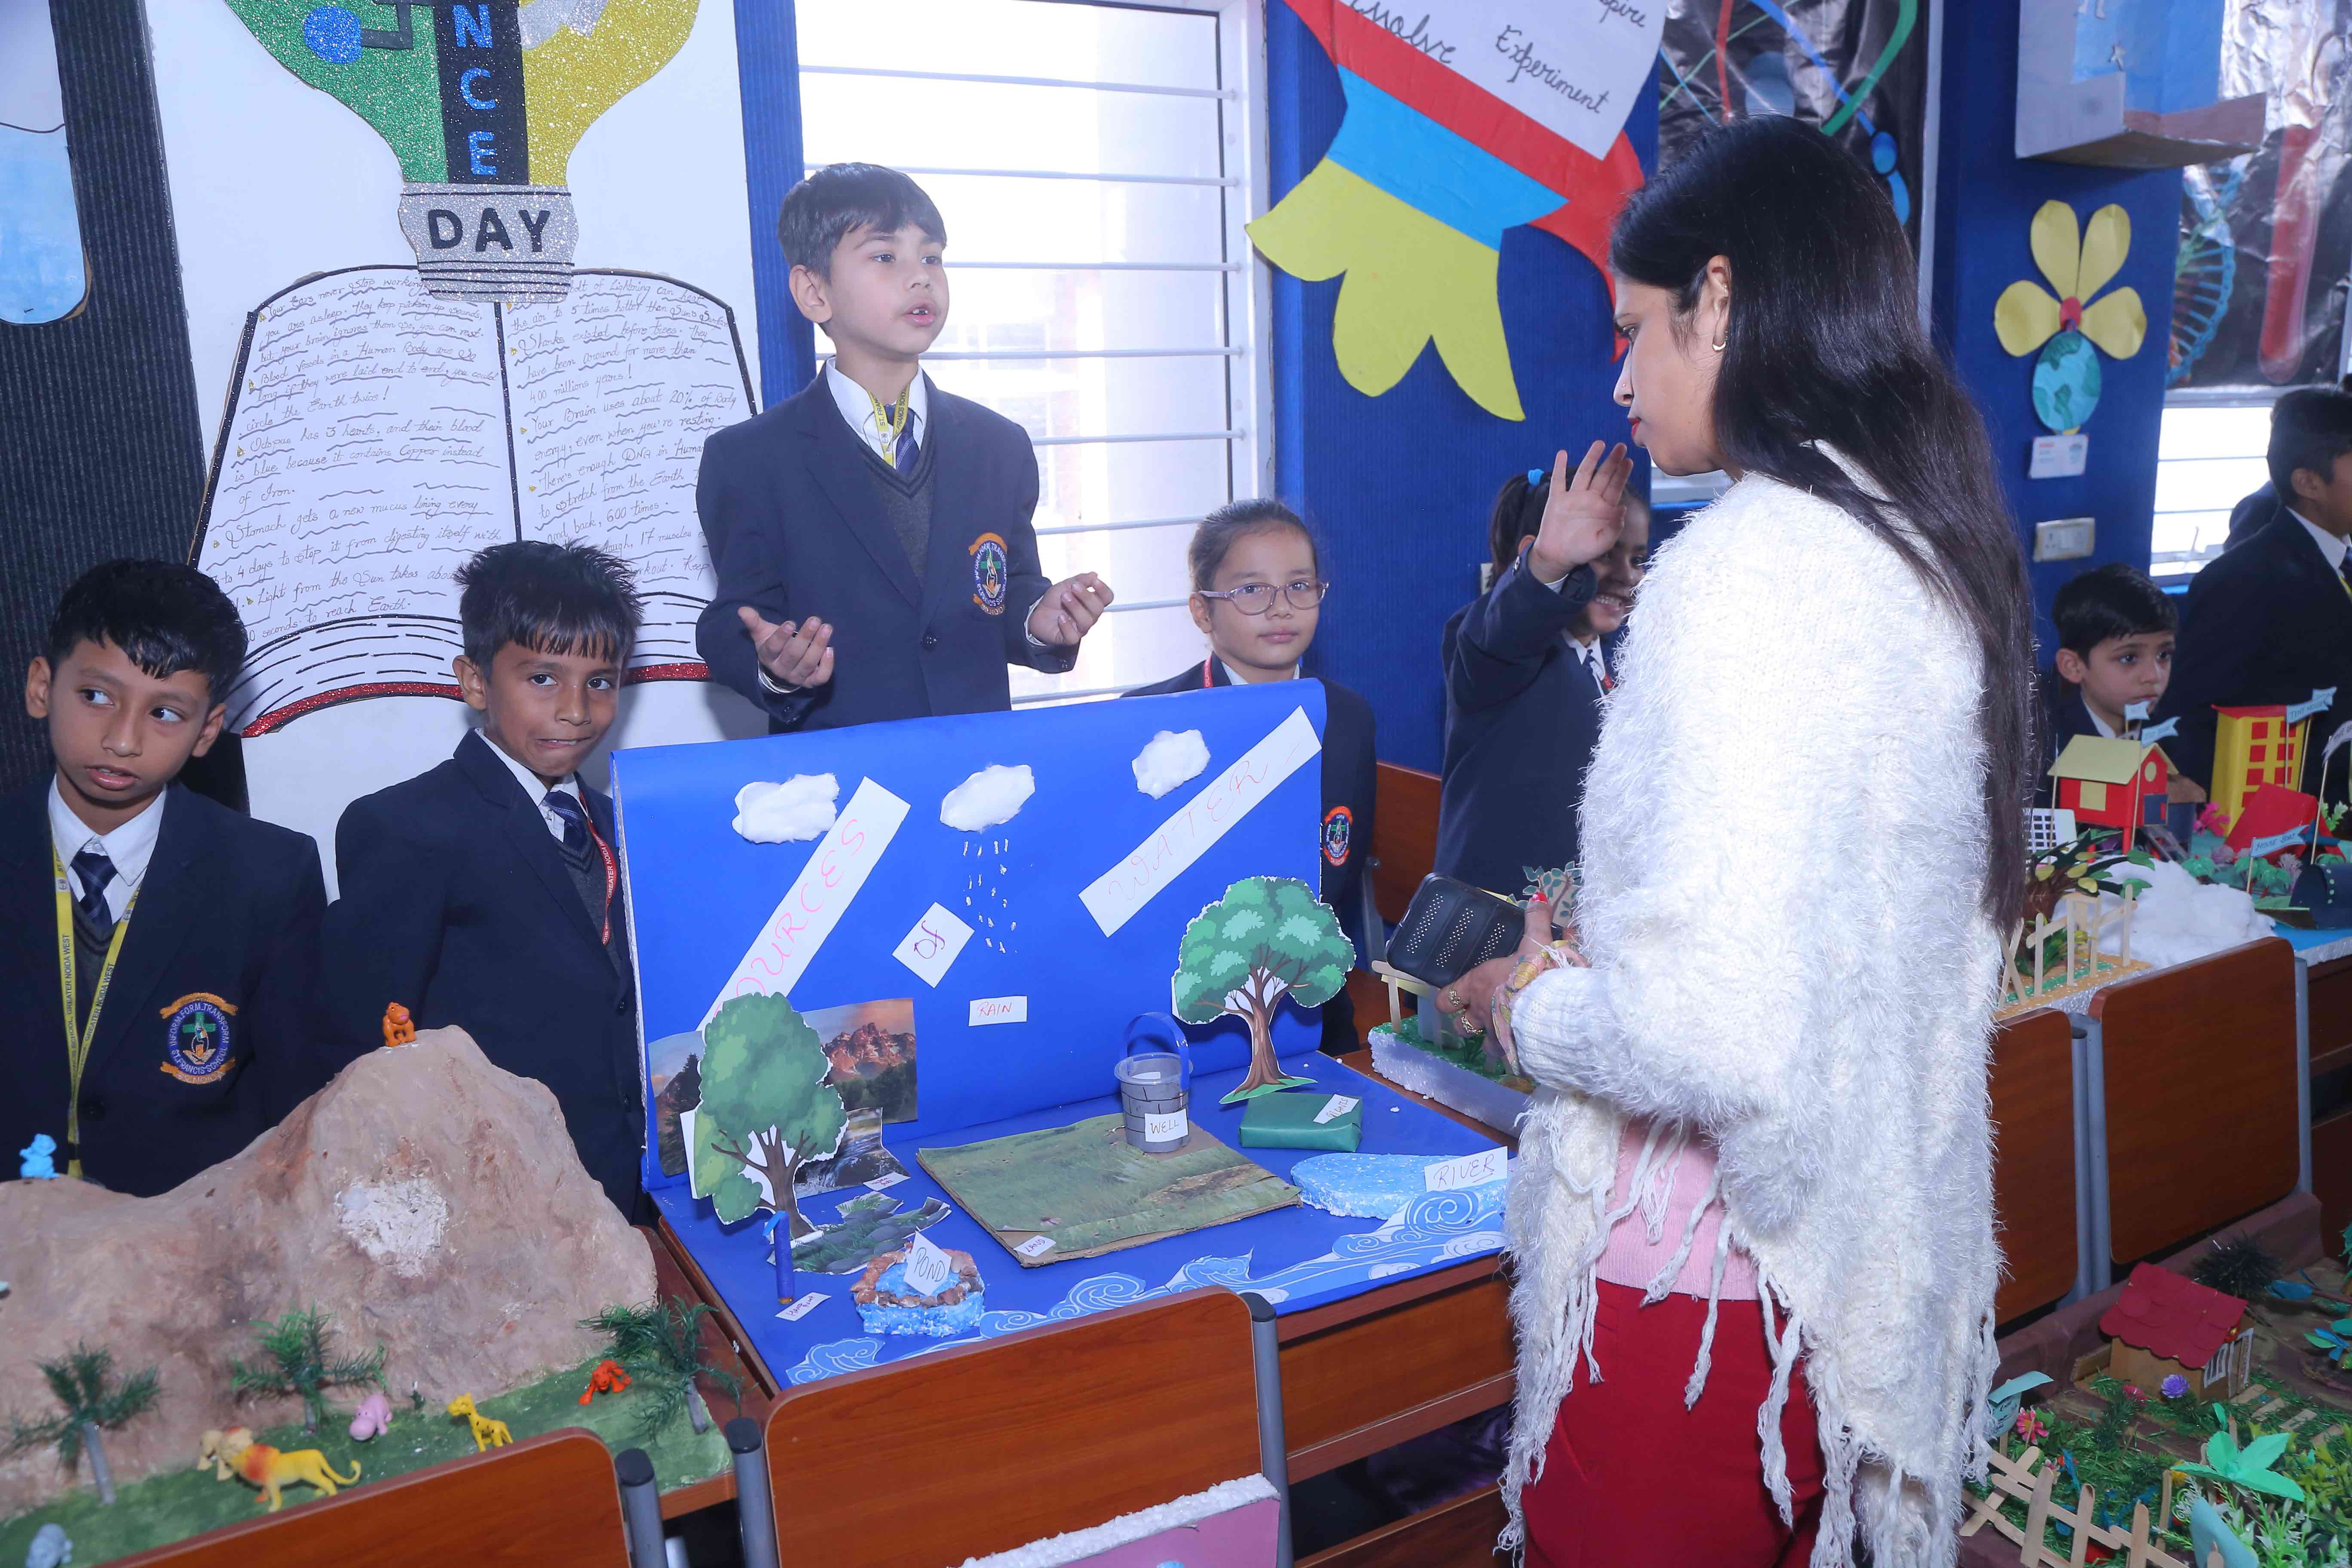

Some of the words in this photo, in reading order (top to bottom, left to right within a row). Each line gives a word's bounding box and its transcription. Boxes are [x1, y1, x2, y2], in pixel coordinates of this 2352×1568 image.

[1496, 25, 1609, 113] Experiment
[427, 208, 550, 252] DAY
[318, 288, 344, 301] never
[594, 279, 605, 297] of
[609, 279, 652, 304] Lightning
[656, 286, 674, 296] can
[680, 289, 706, 303] heat
[287, 319, 305, 331] are
[377, 297, 396, 315] keep
[398, 297, 431, 321] picking
[433, 305, 444, 317] up
[511, 316, 528, 329] the
[533, 312, 546, 322] air
[554, 306, 563, 318] to
[571, 306, 579, 314] 5
[584, 300, 609, 314] times
[646, 300, 668, 313] than
[260, 352, 274, 363] but
[282, 343, 300, 364] your
[306, 333, 330, 346] brain
[334, 326, 369, 346] ignores
[372, 320, 396, 330] them
[420, 323, 435, 339] you
[439, 324, 456, 334] can
[518, 333, 565, 355] Sharks
[573, 325, 609, 340] existed
[621, 321, 648, 341] before
[689, 325, 708, 347] They
[261, 368, 288, 384] Blood
[331, 349, 340, 360] in
[356, 342, 396, 354] Human
[403, 342, 428, 362] Body
[436, 346, 454, 354] are
[528, 365, 547, 380] have
[555, 356, 576, 371] been
[583, 347, 619, 363] around
[625, 346, 640, 361] for
[643, 346, 667, 355] more
[670, 341, 697, 354] than
[257, 389, 277, 410] long
[324, 371, 347, 381] were
[352, 362, 378, 376] laid
[381, 361, 404, 374] end
[408, 361, 417, 373] to
[472, 365, 499, 381] could
[530, 390, 547, 405] 400
[554, 380, 589, 396] millions
[246, 413, 273, 432] circle
[282, 406, 300, 420] the
[307, 393, 347, 412] Earth
[532, 417, 554, 431] Your
[564, 405, 596, 422] Brain
[603, 401, 625, 413] uses
[632, 391, 663, 407] about
[669, 389, 693, 404] 20%
[701, 392, 712, 408] of
[250, 437, 292, 455] Octopus
[301, 428, 319, 441] has
[386, 419, 410, 433] and
[415, 421, 444, 432] their
[450, 419, 485, 432] blood
[575, 433, 603, 447] even
[608, 423, 635, 440] when
[636, 419, 673, 444] you're
[235, 470, 245, 482] is
[254, 459, 279, 476] blue
[286, 455, 328, 469] because
[334, 451, 344, 463] it
[350, 447, 392, 459] contains
[398, 444, 439, 462] Copper
[442, 446, 484, 456] instead
[539, 469, 572, 490] There's
[578, 453, 616, 481] enough
[622, 447, 651, 461] DNA
[655, 443, 668, 456] in
[239, 489, 250, 512] of
[539, 505, 550, 518] to
[601, 481, 624, 501] from
[628, 474, 646, 489] the
[649, 469, 684, 486] Earth
[225, 515, 286, 549] Stomach
[290, 510, 319, 534] gets
[342, 505, 364, 516] new
[371, 502, 408, 512] mucus
[413, 495, 441, 520] lining
[448, 501, 478, 518] every
[547, 524, 568, 543] and
[606, 504, 627, 522] 600
[640, 527, 655, 545] 17
[658, 526, 692, 541] muscles
[222, 571, 233, 584] to
[237, 565, 244, 578] 4
[279, 551, 290, 566] to
[331, 540, 342, 553] it
[346, 535, 377, 556] from
[383, 527, 431, 549] digesting
[434, 525, 470, 543] itself
[474, 529, 502, 540] with
[683, 554, 710, 580] Keep
[258, 584, 287, 617] Light
[293, 582, 321, 602] from
[330, 571, 348, 586] the
[352, 570, 385, 586] Sun
[389, 564, 419, 579] takes
[263, 617, 298, 636] seconds
[304, 609, 317, 623] to
[325, 599, 356, 618] reach
[1108, 760, 1268, 901] WATER
[602, 847, 612, 864] NOIDA
[103, 963, 115, 983] WEST
[96, 984, 107, 1008] NOIDA
[977, 1001, 1013, 1017] RAIN
[86, 1009, 101, 1041] GREATER
[205, 1047, 227, 1072] SCHOOL
[1326, 1097, 1348, 1118] PLANTS
[1150, 1119, 1179, 1133] WELL
[1433, 1153, 1494, 1189] RIVER
[1025, 1239, 1045, 1253] LAND
[914, 1247, 946, 1282] POND
